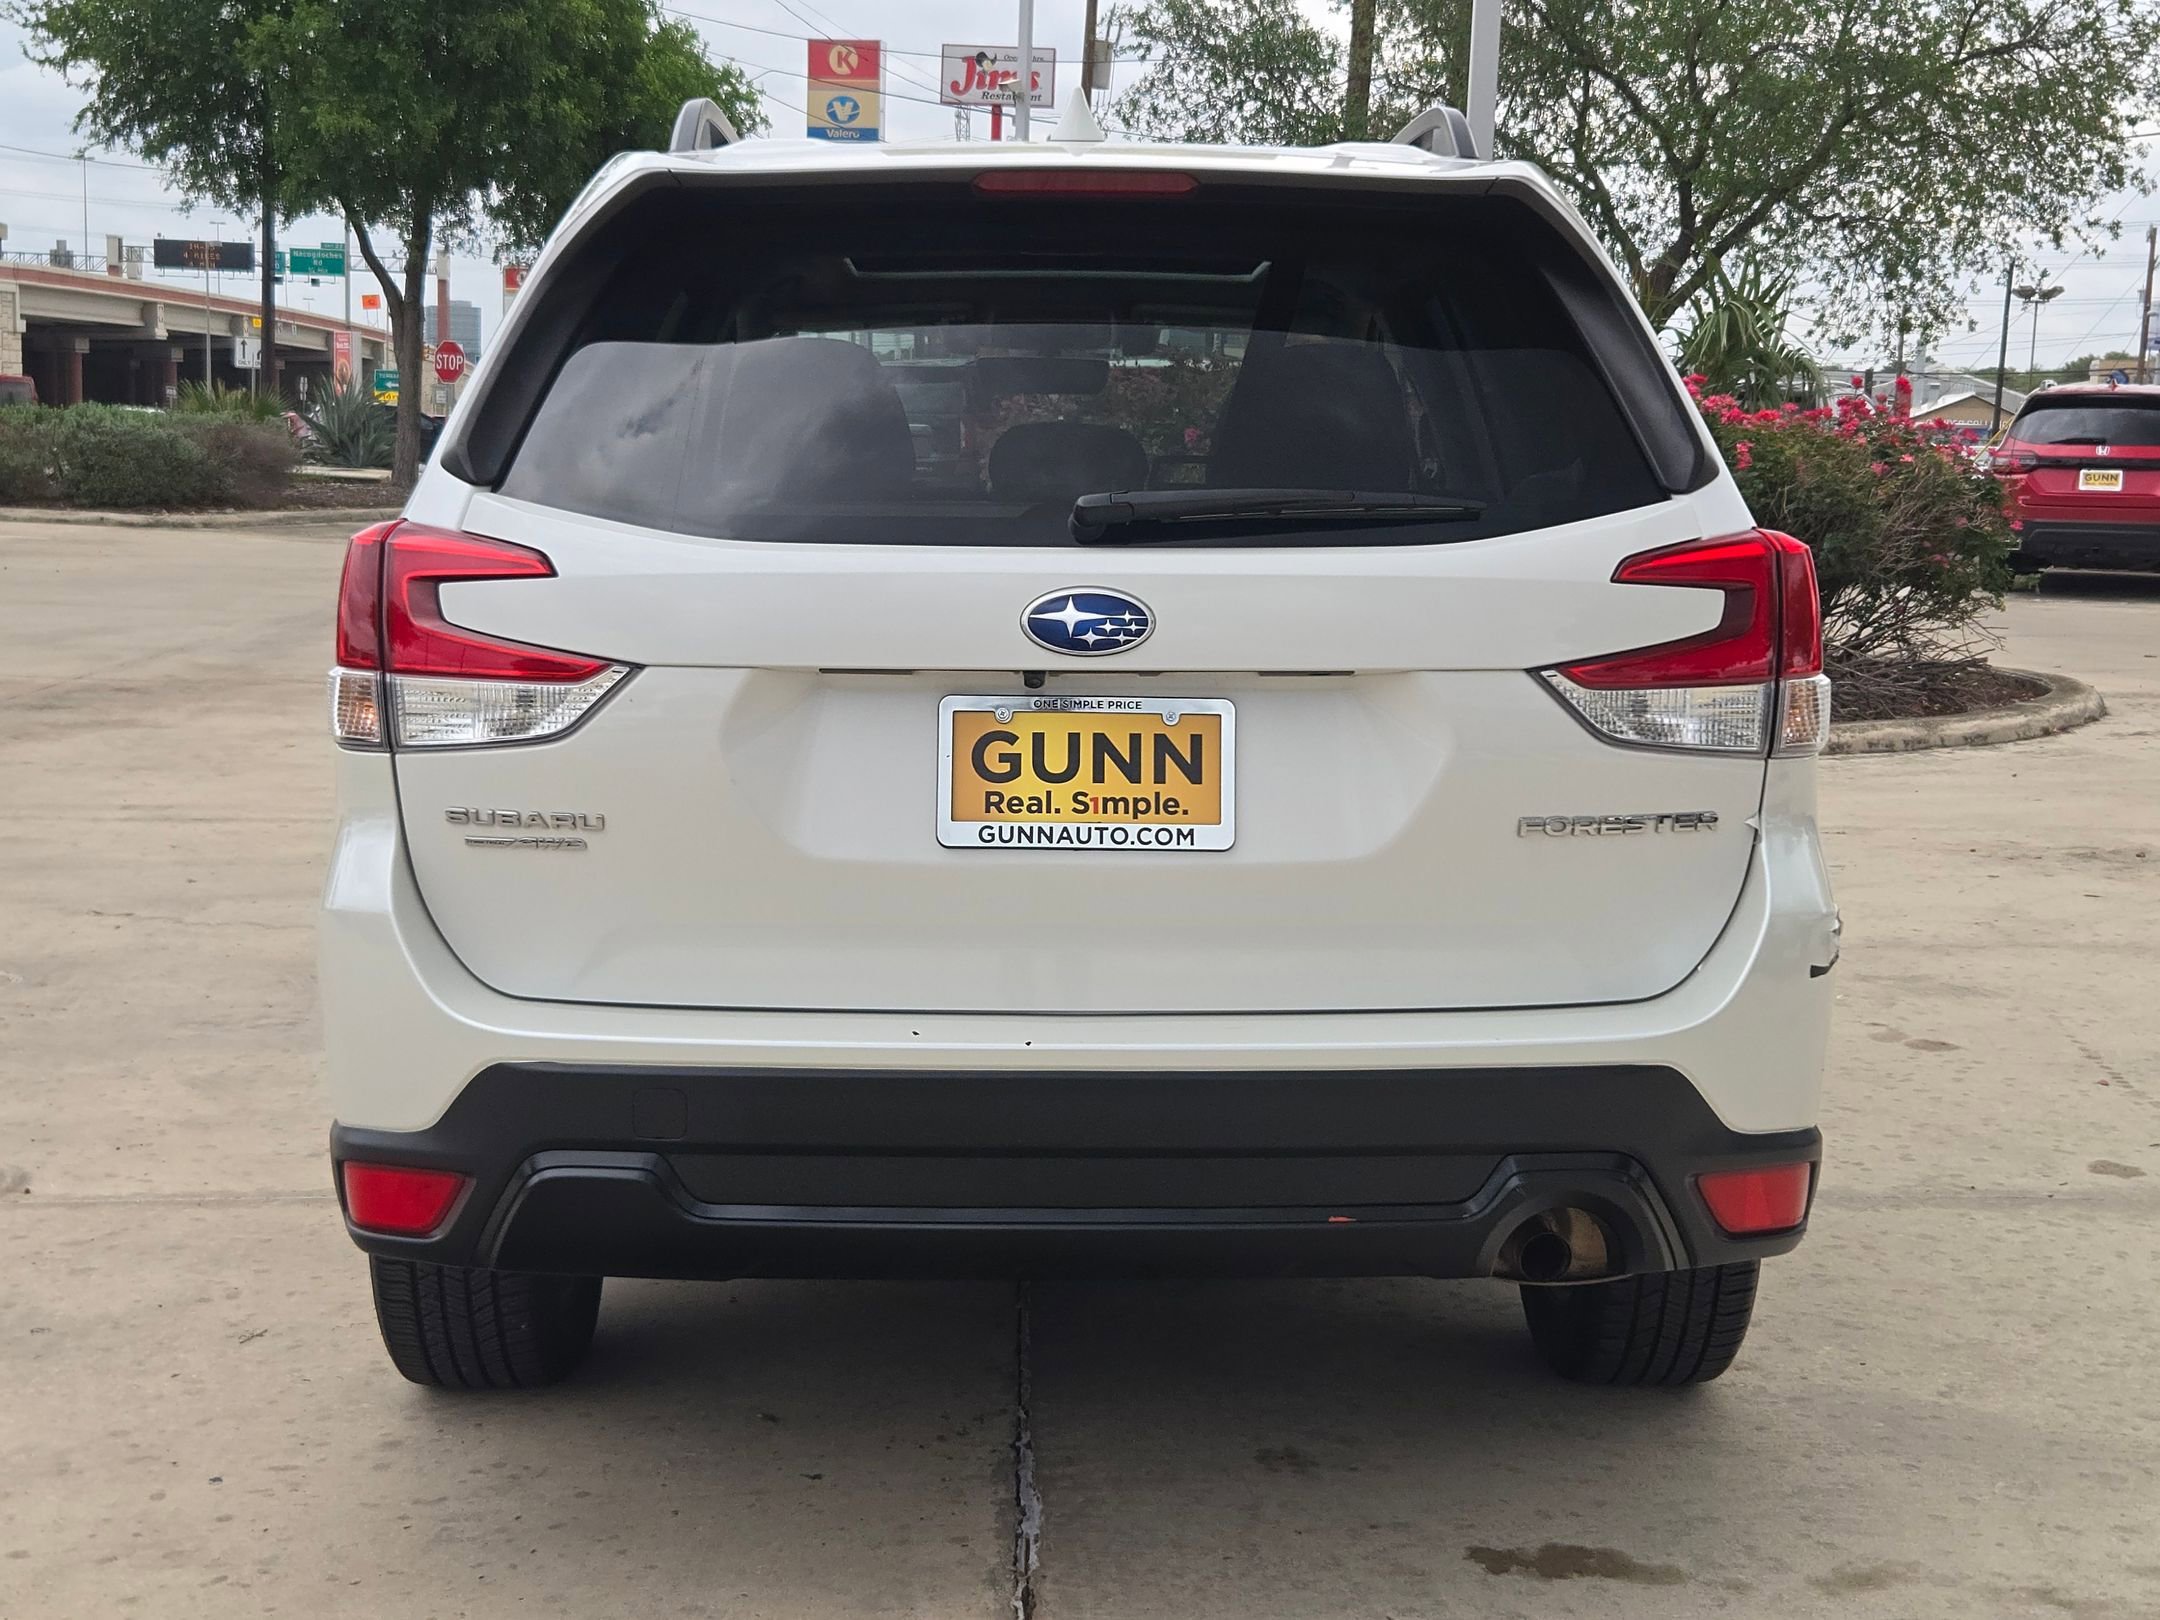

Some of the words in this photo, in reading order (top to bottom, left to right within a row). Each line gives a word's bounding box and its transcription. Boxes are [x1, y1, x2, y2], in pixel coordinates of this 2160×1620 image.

[950, 56, 1041, 97] Jims
[982, 91, 1042, 102] Restant
[826, 129, 860, 138] Valero
[293, 250, 343, 259] Nacogdoches
[436, 353, 464, 371] STOP
[2085, 473, 2119, 481] GUNN
[1033, 699, 1059, 709] ONE
[1062, 700, 1104, 710] SIMPLE
[1107, 700, 1143, 710] PRICE
[971, 729, 1203, 785] GUNN
[984, 790, 1061, 815] Real.
[444, 806, 606, 832] SUBARU
[1517, 810, 1720, 837] FORESTER
[978, 825, 1195, 846] GUNNAUTO.COM
